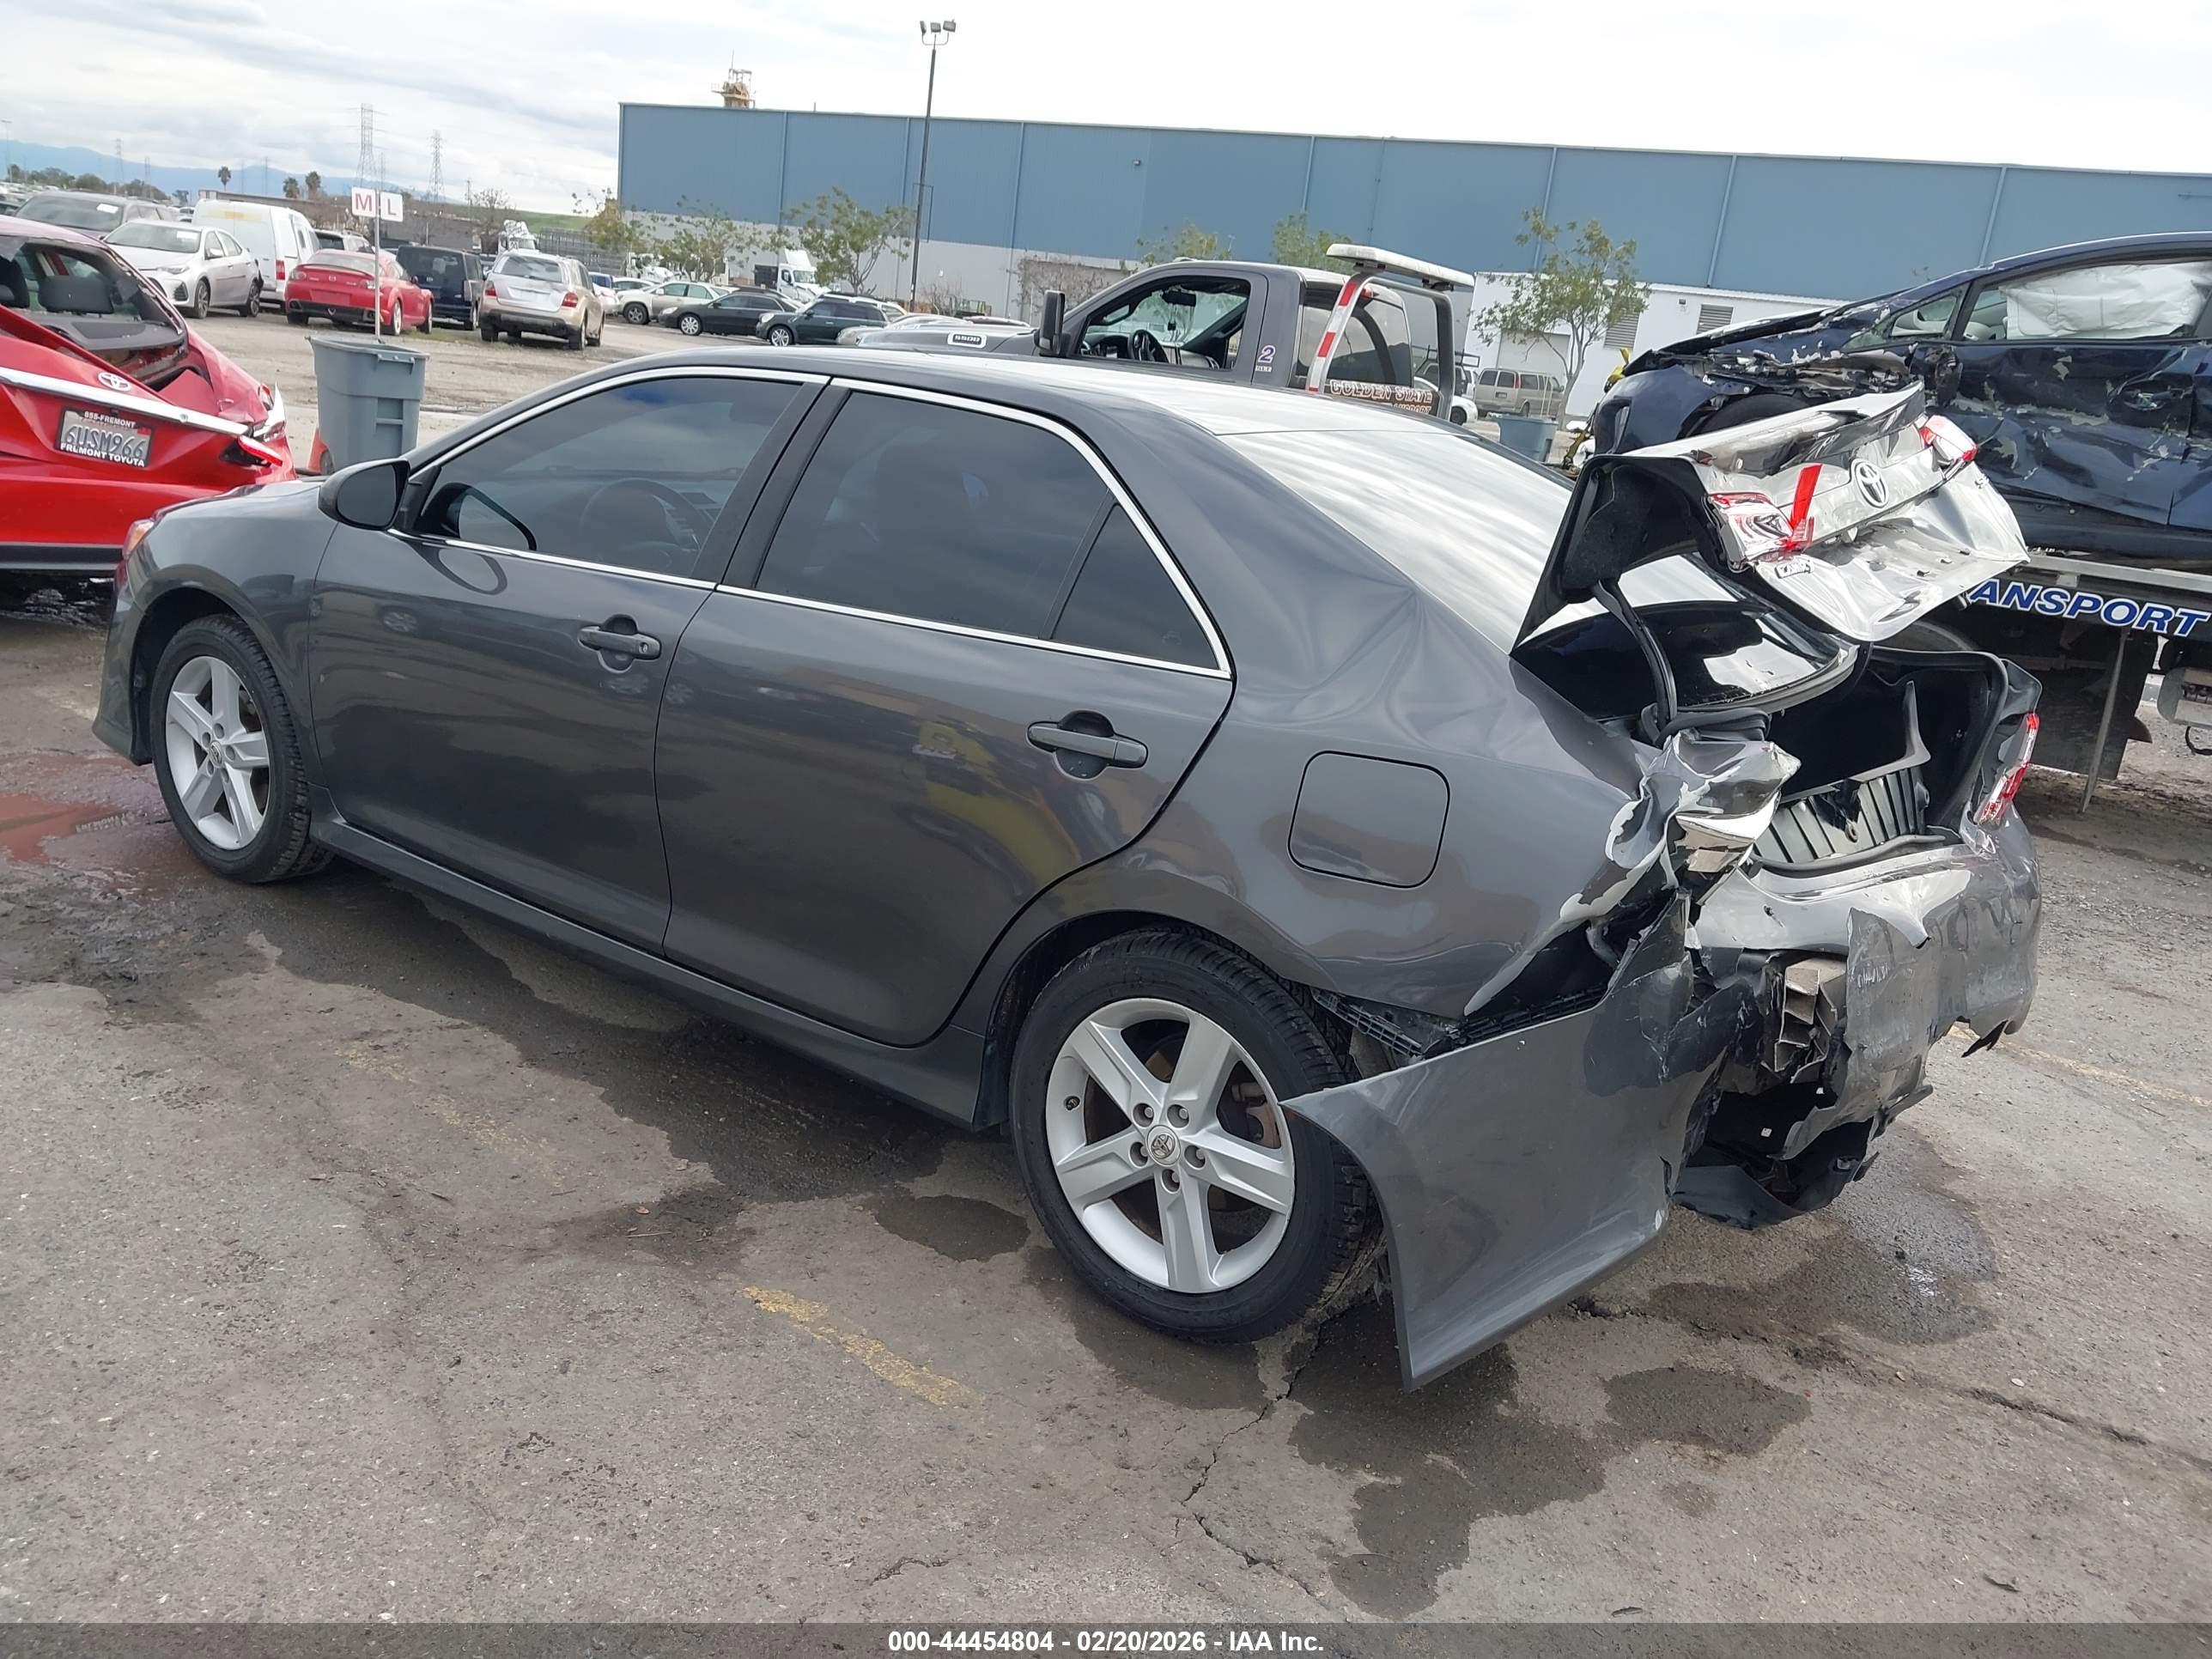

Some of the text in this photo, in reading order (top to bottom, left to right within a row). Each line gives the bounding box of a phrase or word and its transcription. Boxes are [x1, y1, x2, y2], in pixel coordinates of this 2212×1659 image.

[356, 193, 372, 211] M
[387, 198, 397, 216] L
[1258, 344, 1276, 363] 2
[1330, 380, 1433, 404] GOLDEN STATE
[64, 424, 145, 459] 6USM966
[1959, 578, 2211, 637] ANSPORT
